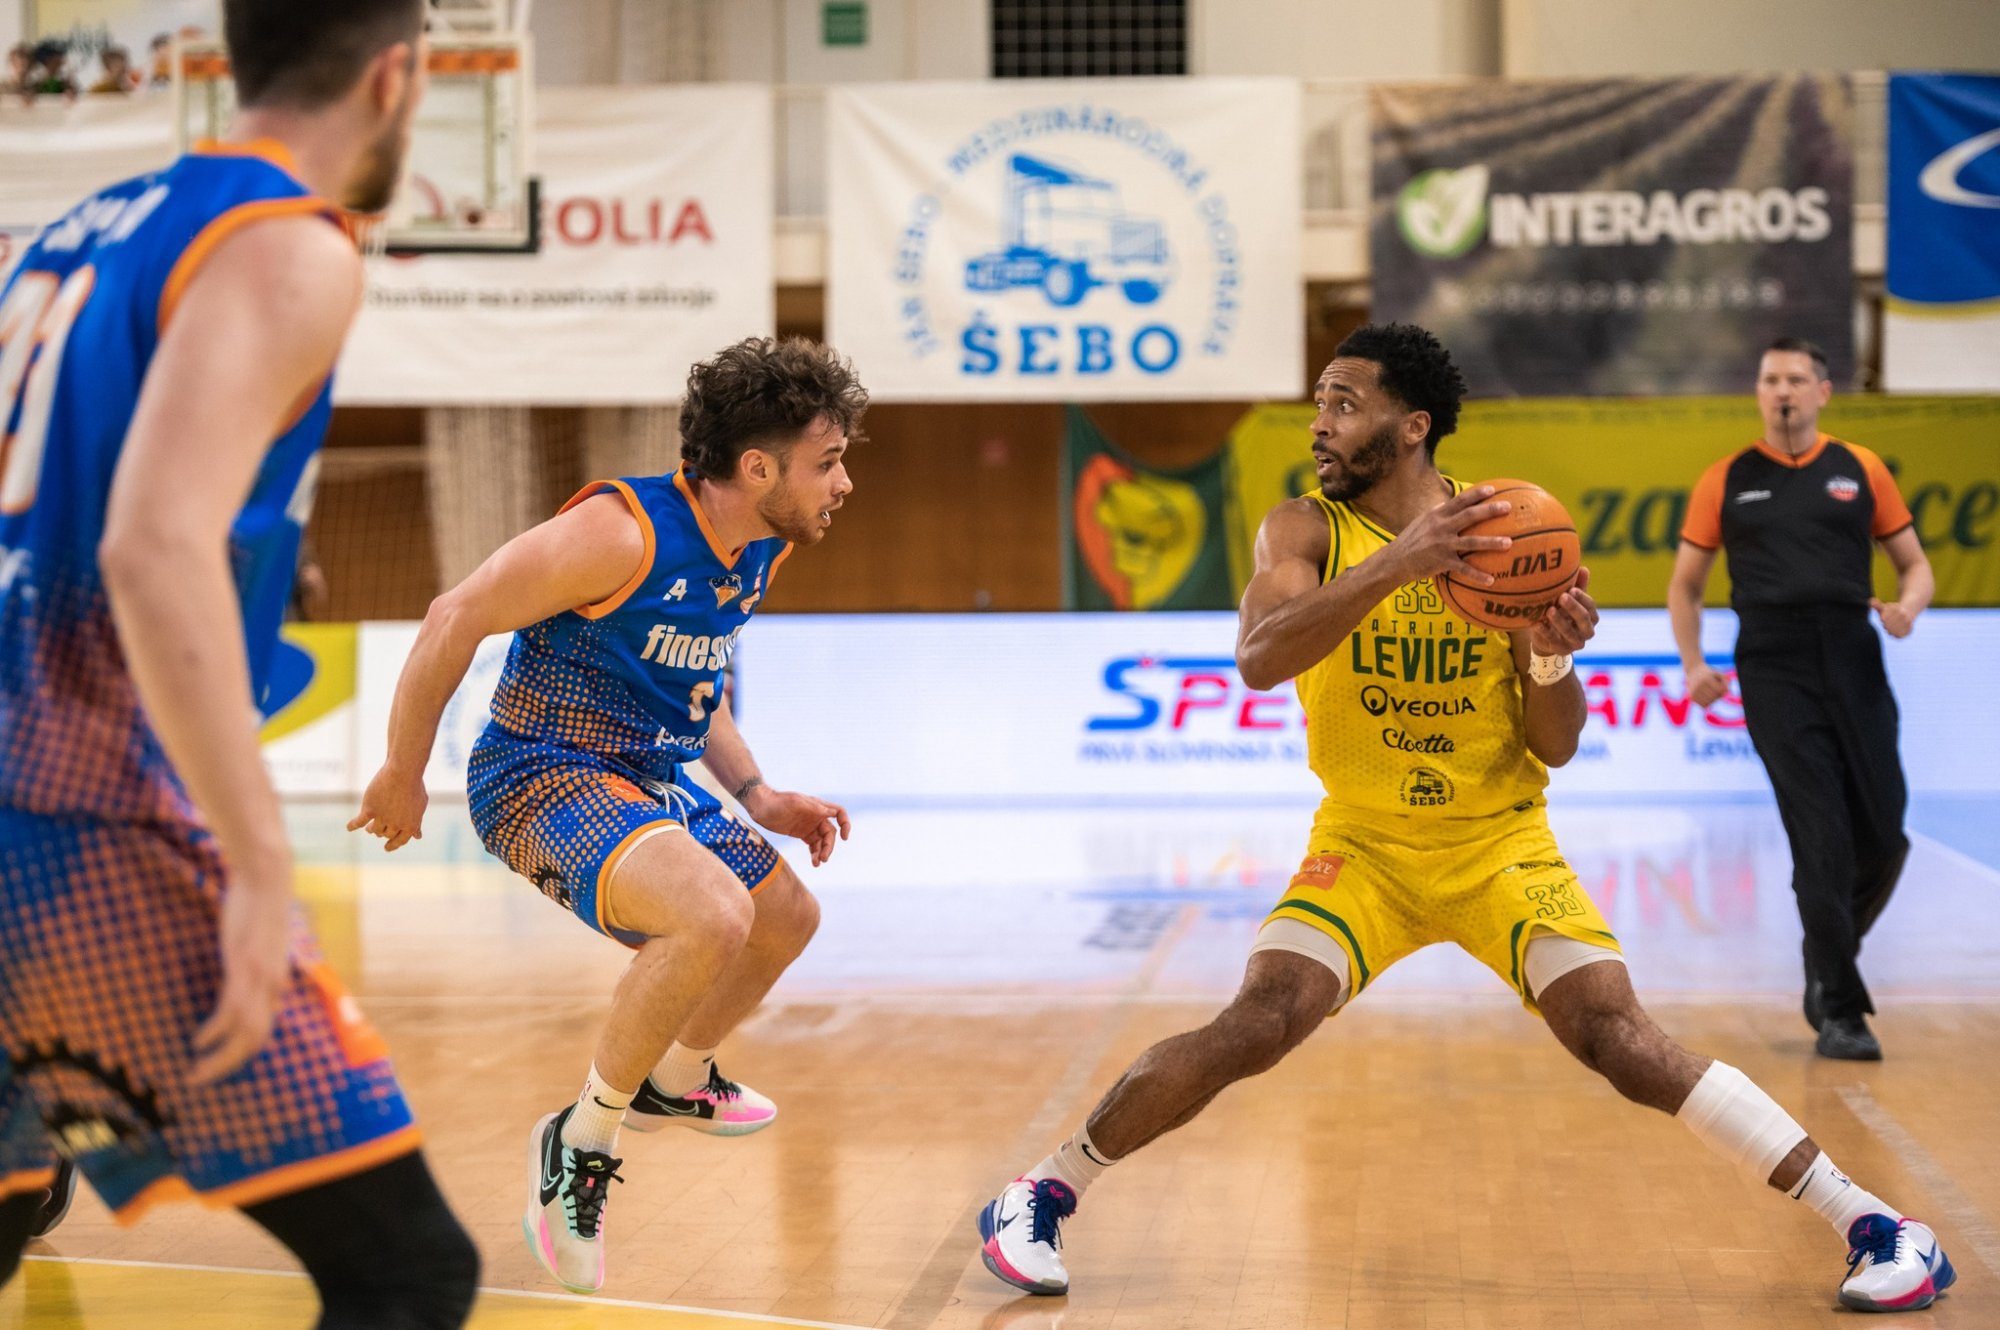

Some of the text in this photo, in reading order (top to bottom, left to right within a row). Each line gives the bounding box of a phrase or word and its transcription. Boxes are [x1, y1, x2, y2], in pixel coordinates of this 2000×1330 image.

[545, 197, 716, 246] OLIA
[1489, 187, 1832, 248] INTERAGROS
[959, 309, 1181, 377] ŠEBO
[1510, 547, 1564, 578] EVO
[1369, 618, 1488, 635] ATRIOT
[1352, 631, 1488, 684] LEVICE
[1389, 696, 1477, 717] VEOLIA
[1382, 727, 1456, 754] Cloetta
[1409, 794, 1447, 806] ŠEBO
[1525, 879, 1586, 920] 33
